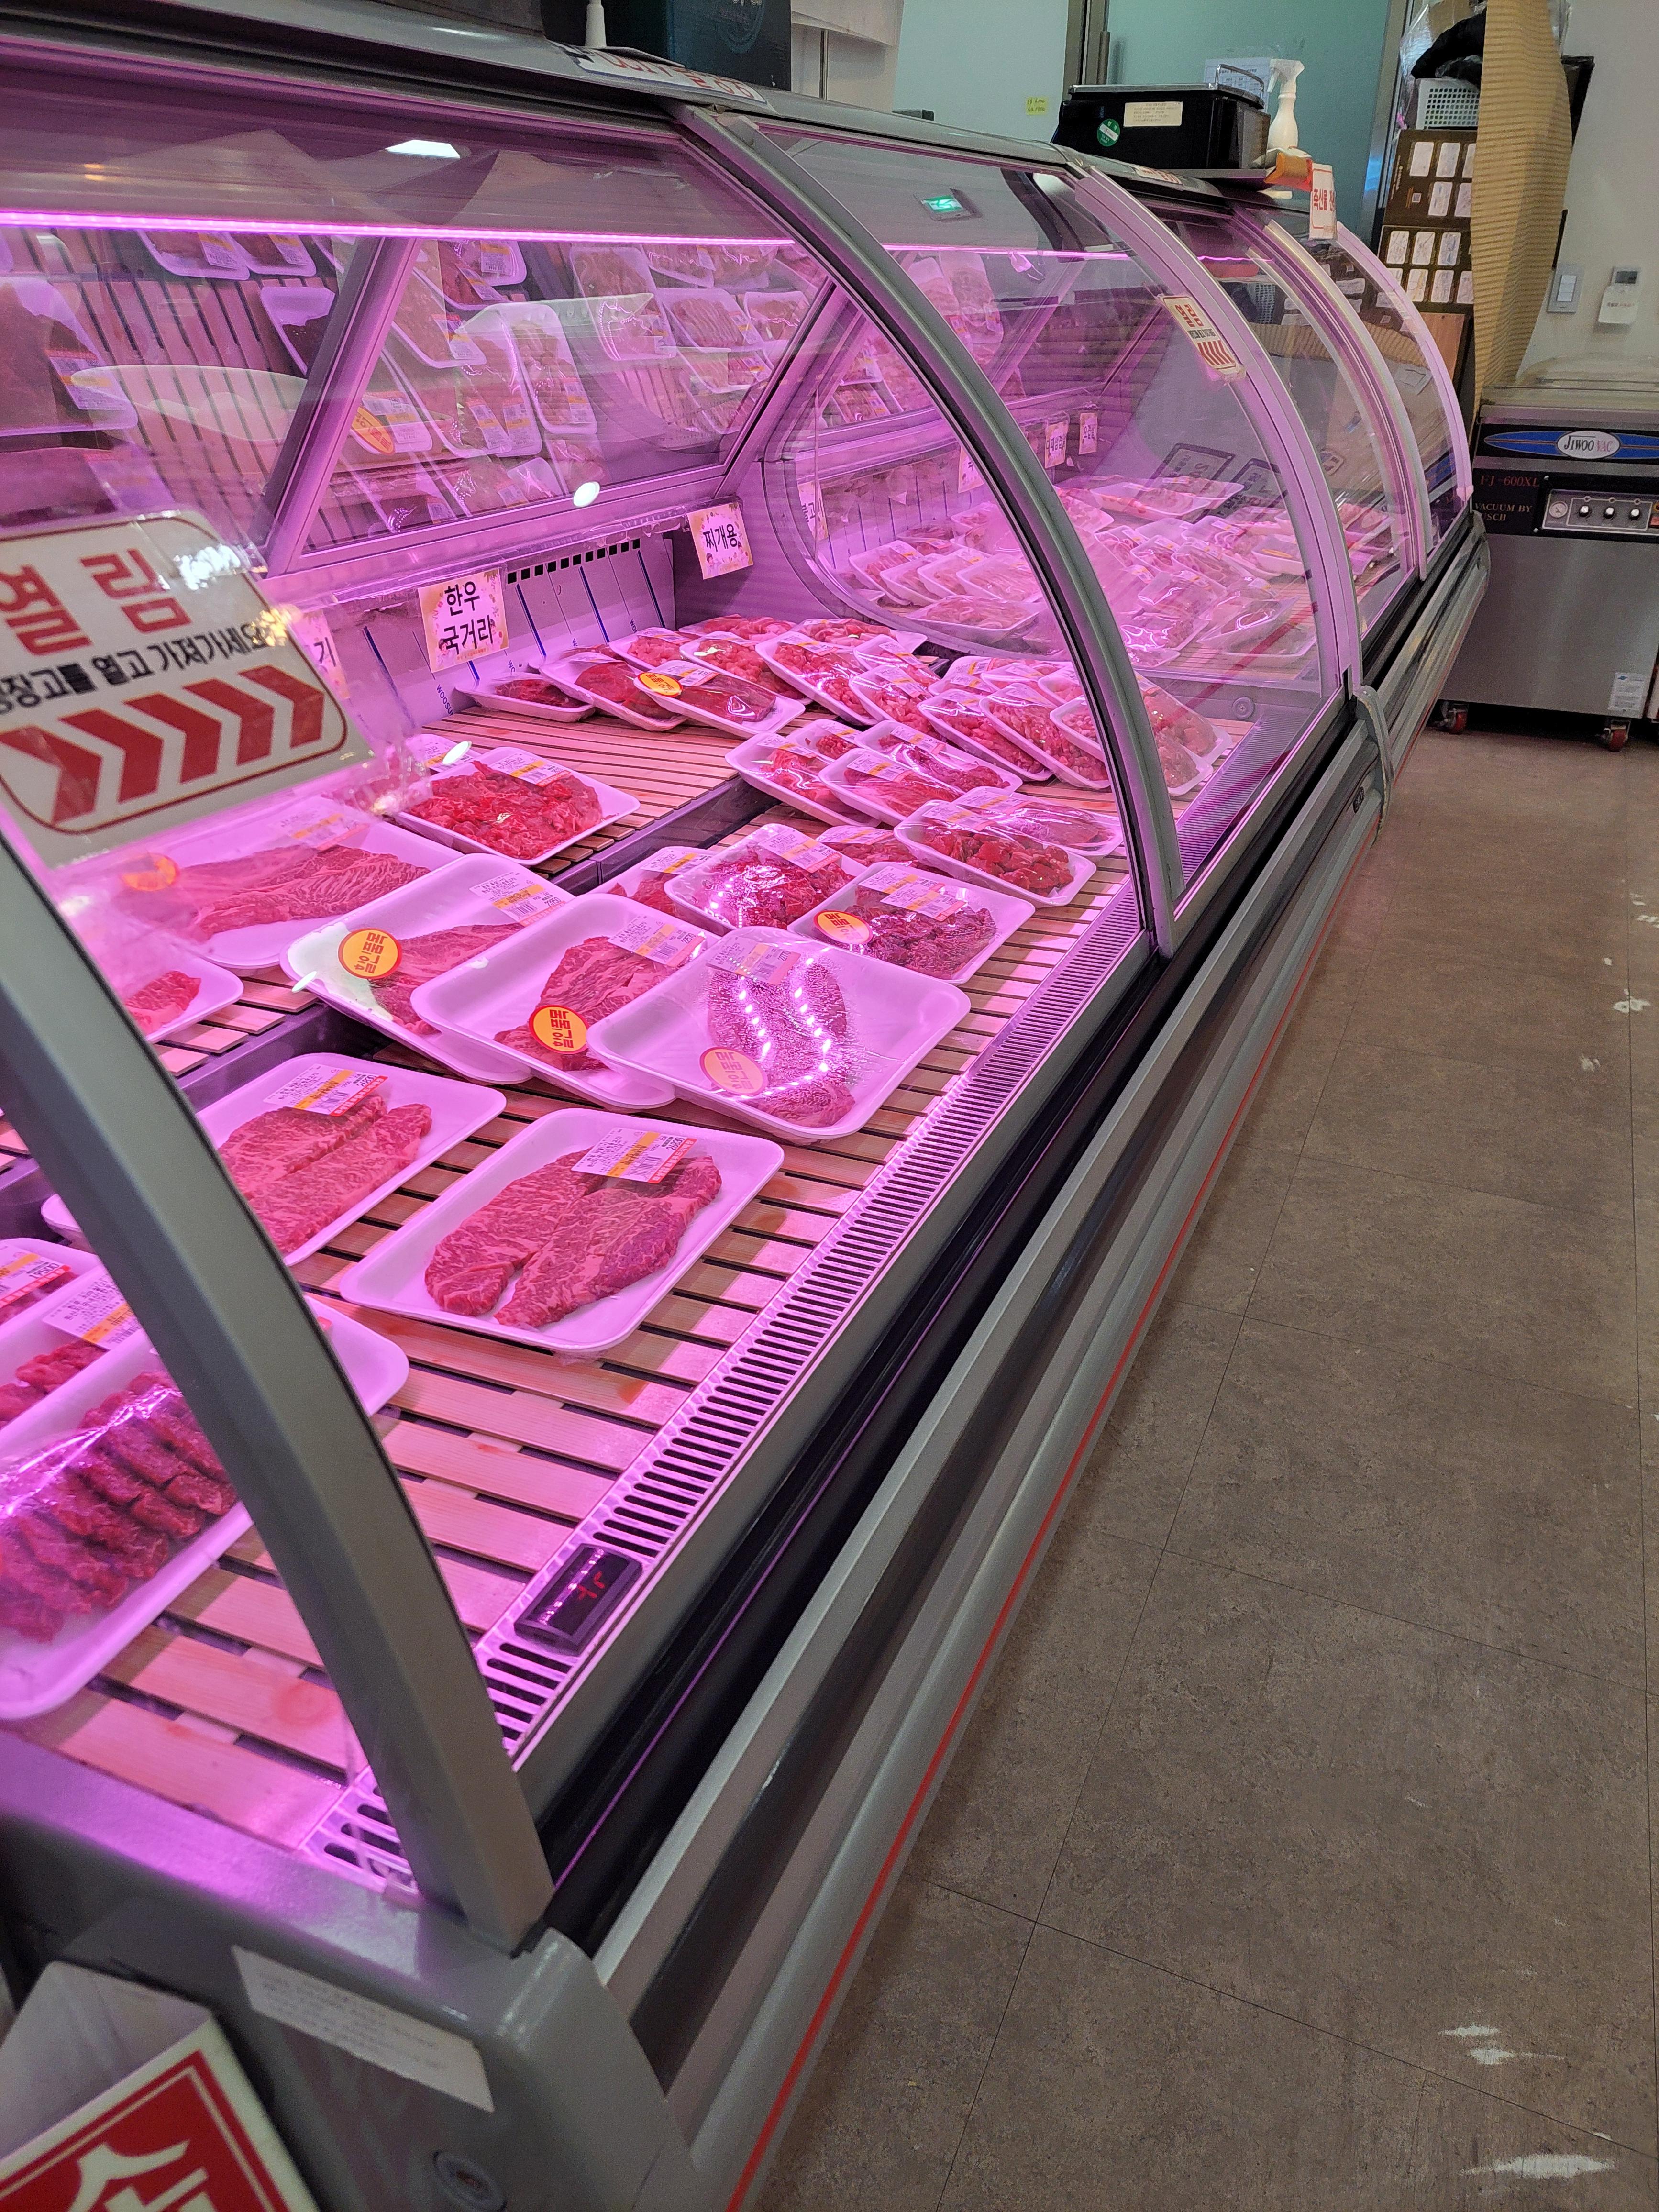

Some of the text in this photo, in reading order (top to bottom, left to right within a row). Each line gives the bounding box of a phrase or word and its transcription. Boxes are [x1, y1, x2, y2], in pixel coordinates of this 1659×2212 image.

[1314, 188, 1327, 210] 축산물
[1174, 303, 1204, 328] 열림
[1563, 435, 1613, 452] JIWOO VAC
[1518, 505, 1532, 513] BY
[703, 524, 738, 552] 찌개용
[444, 581, 480, 617] 한우
[443, 614, 494, 655] 국거리
[91, 649, 155, 686] 열고
[354, 931, 388, 974] 할인품목
[549, 1009, 574, 1049] 할인품목
[715, 1051, 754, 1091] 할인품목
[665, 1137, 686, 1151] 26830
[29, 1263, 60, 1280] 19500
